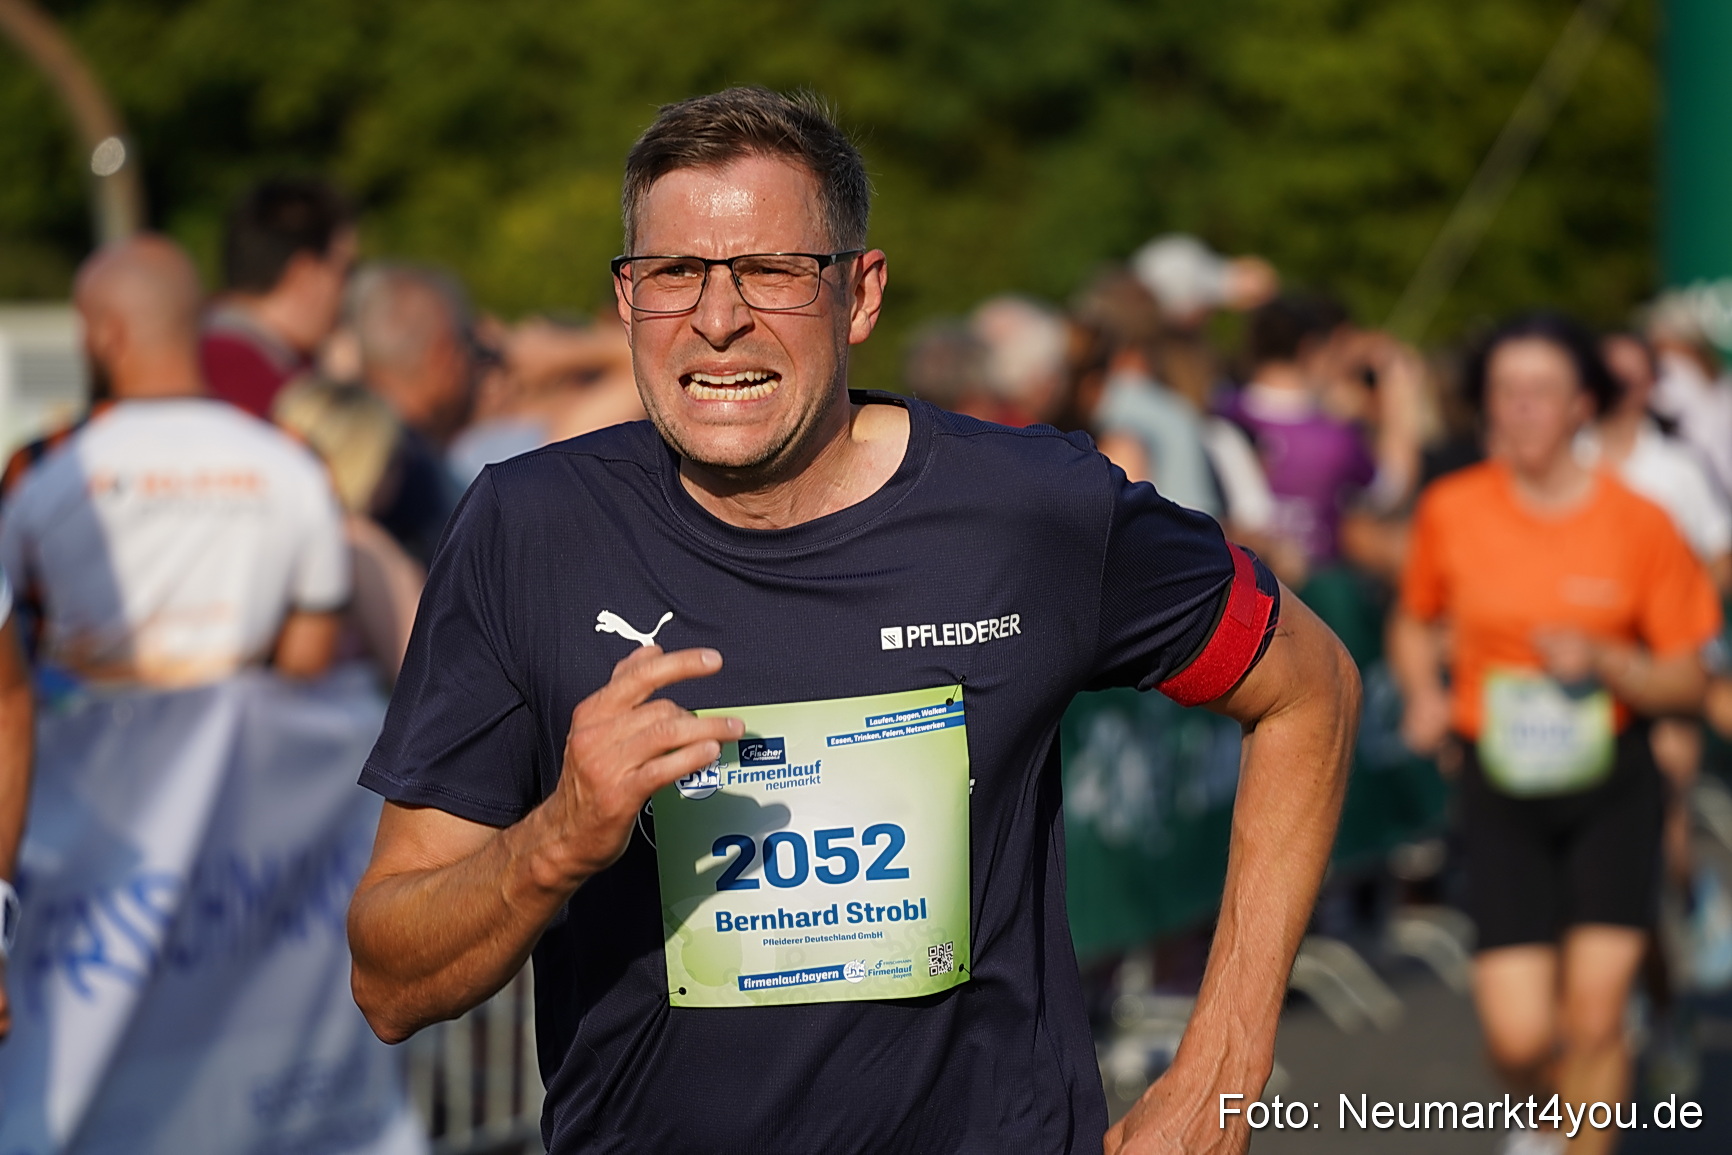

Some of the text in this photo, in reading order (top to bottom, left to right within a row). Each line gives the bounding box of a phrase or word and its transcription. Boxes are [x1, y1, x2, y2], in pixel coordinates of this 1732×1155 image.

[906, 613, 1022, 648] PFLEIDERER
[869, 706, 947, 726] Laufen, Joggen, Walken
[830, 720, 946, 746] Essen, Trinken, Feiern, Netzwerken
[750, 746, 783, 758] Fischer
[727, 760, 822, 786] Firmenlauf
[765, 775, 821, 791] neumarkt
[711, 823, 910, 892] 2052
[715, 897, 928, 933] Bernhard Strobl
[762, 930, 883, 947] Pfleiderer Deutschland GmbH
[743, 968, 840, 989] firmenlauf.bayern
[867, 964, 913, 977] Firmenlauf
